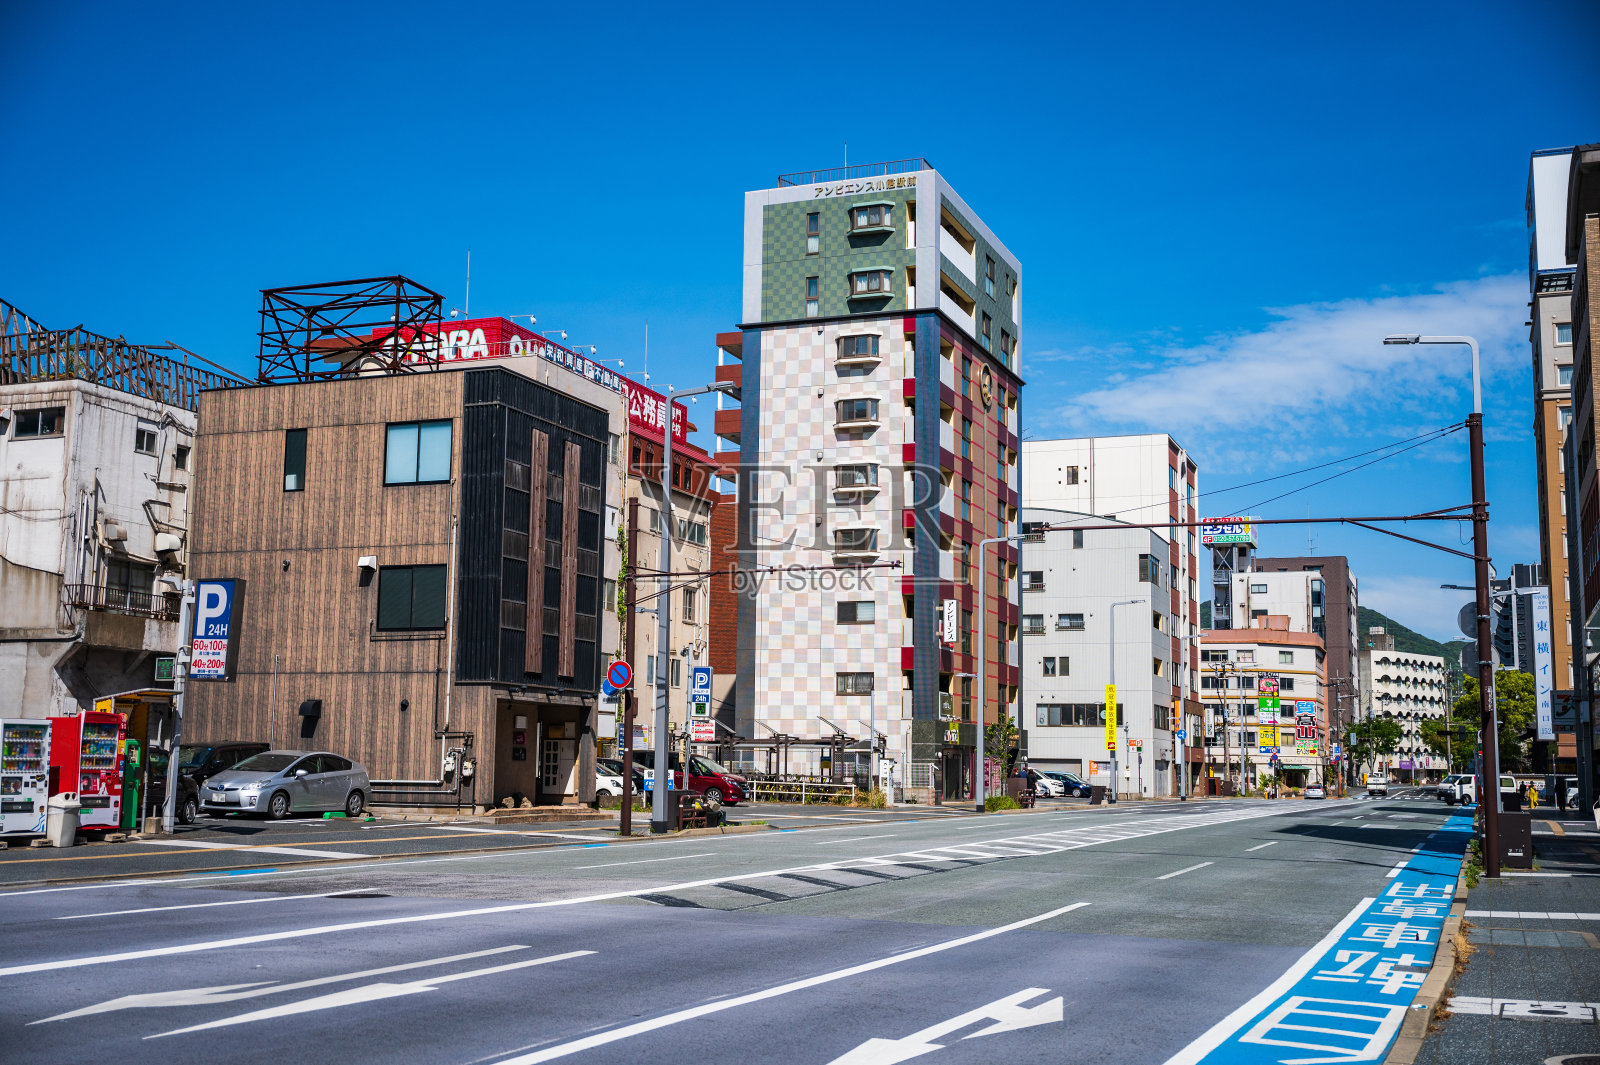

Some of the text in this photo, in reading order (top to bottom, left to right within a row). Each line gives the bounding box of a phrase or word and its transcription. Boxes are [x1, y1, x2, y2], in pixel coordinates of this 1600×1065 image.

[196, 584, 228, 637] P
[207, 623, 228, 636] 24H
[1536, 620, 1551, 695] 東横イン
[696, 672, 708, 690] P
